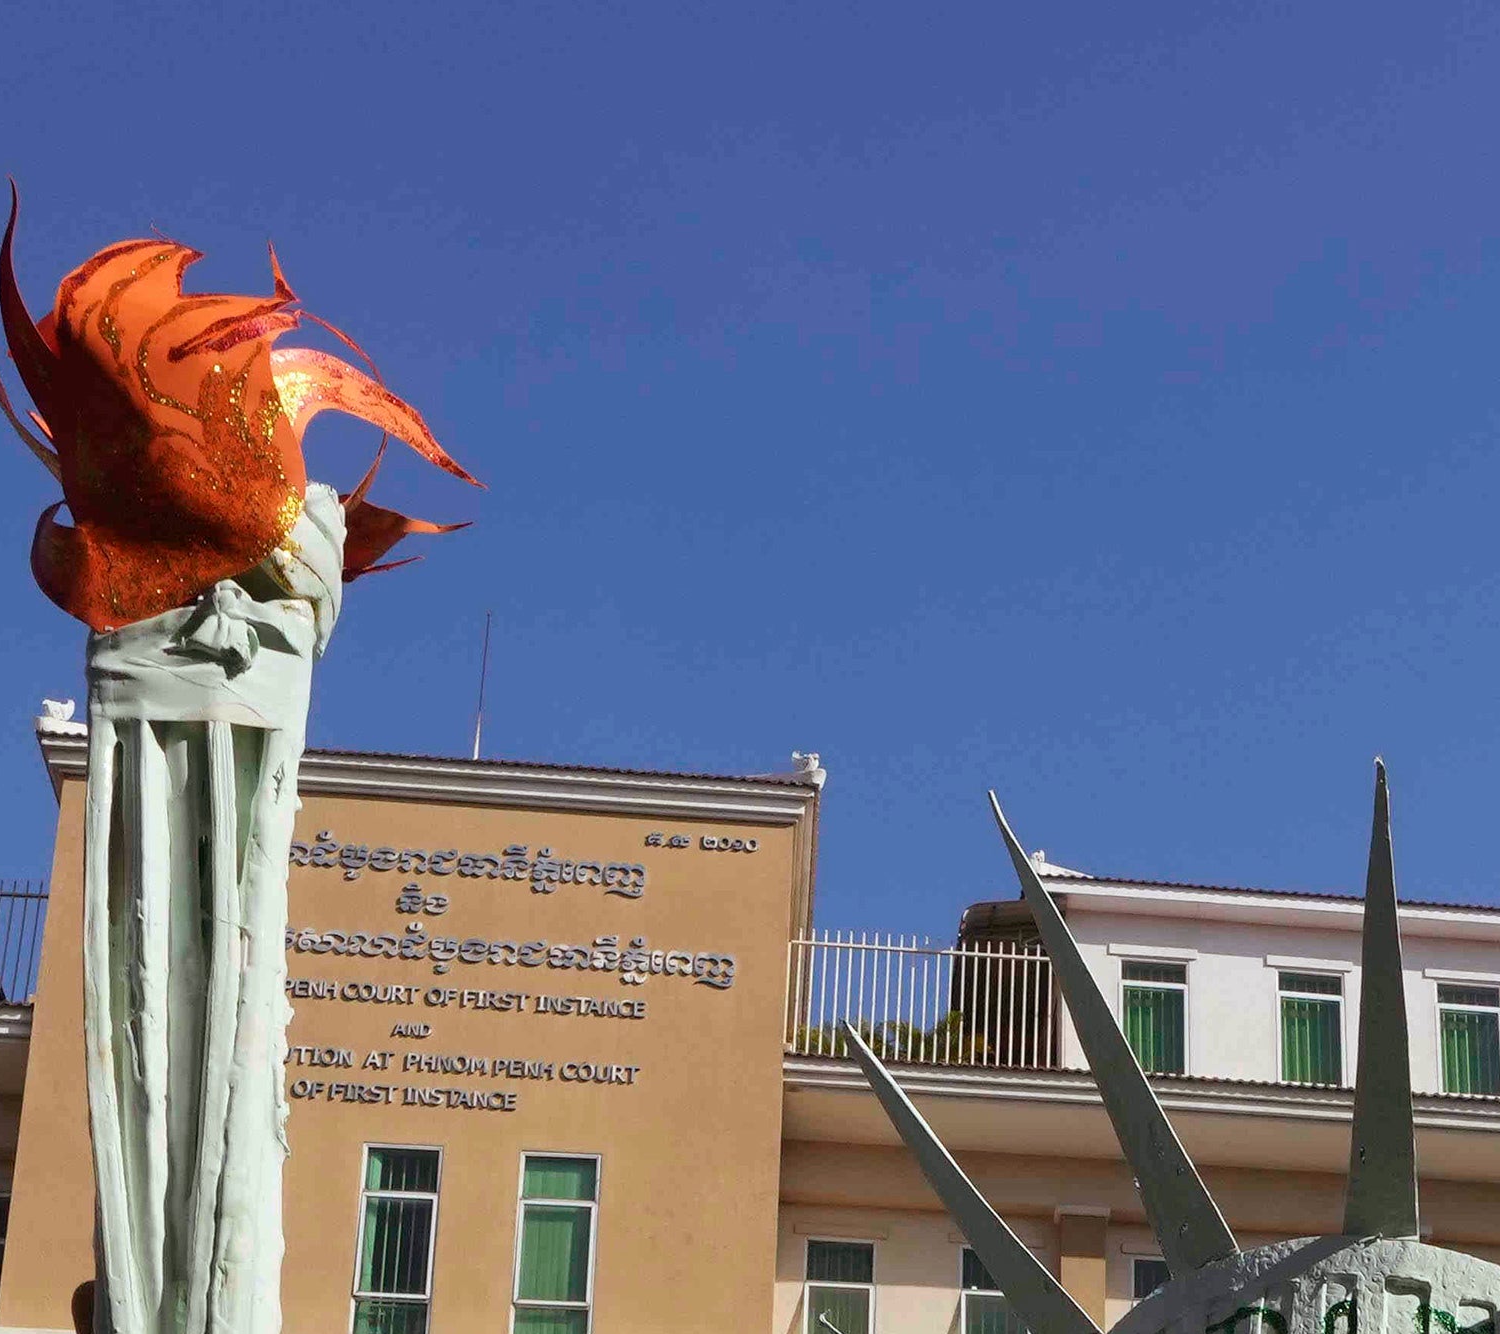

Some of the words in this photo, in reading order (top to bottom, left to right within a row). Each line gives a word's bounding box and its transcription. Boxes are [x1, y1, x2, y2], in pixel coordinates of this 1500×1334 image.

[396, 881, 450, 915] និង
[341, 981, 419, 1006] COURT
[425, 985, 458, 1007] OF
[460, 988, 530, 1012] FIRST
[534, 994, 646, 1019] INSTANCE
[390, 1020, 434, 1039] AND
[363, 1050, 395, 1071] AT
[402, 1052, 490, 1077] PHNOM
[491, 1058, 556, 1081] PENH
[558, 1061, 641, 1086] COURT
[290, 1078, 327, 1100] OF
[327, 1081, 400, 1105] FIRST
[401, 1086, 519, 1113] INSTANCE
